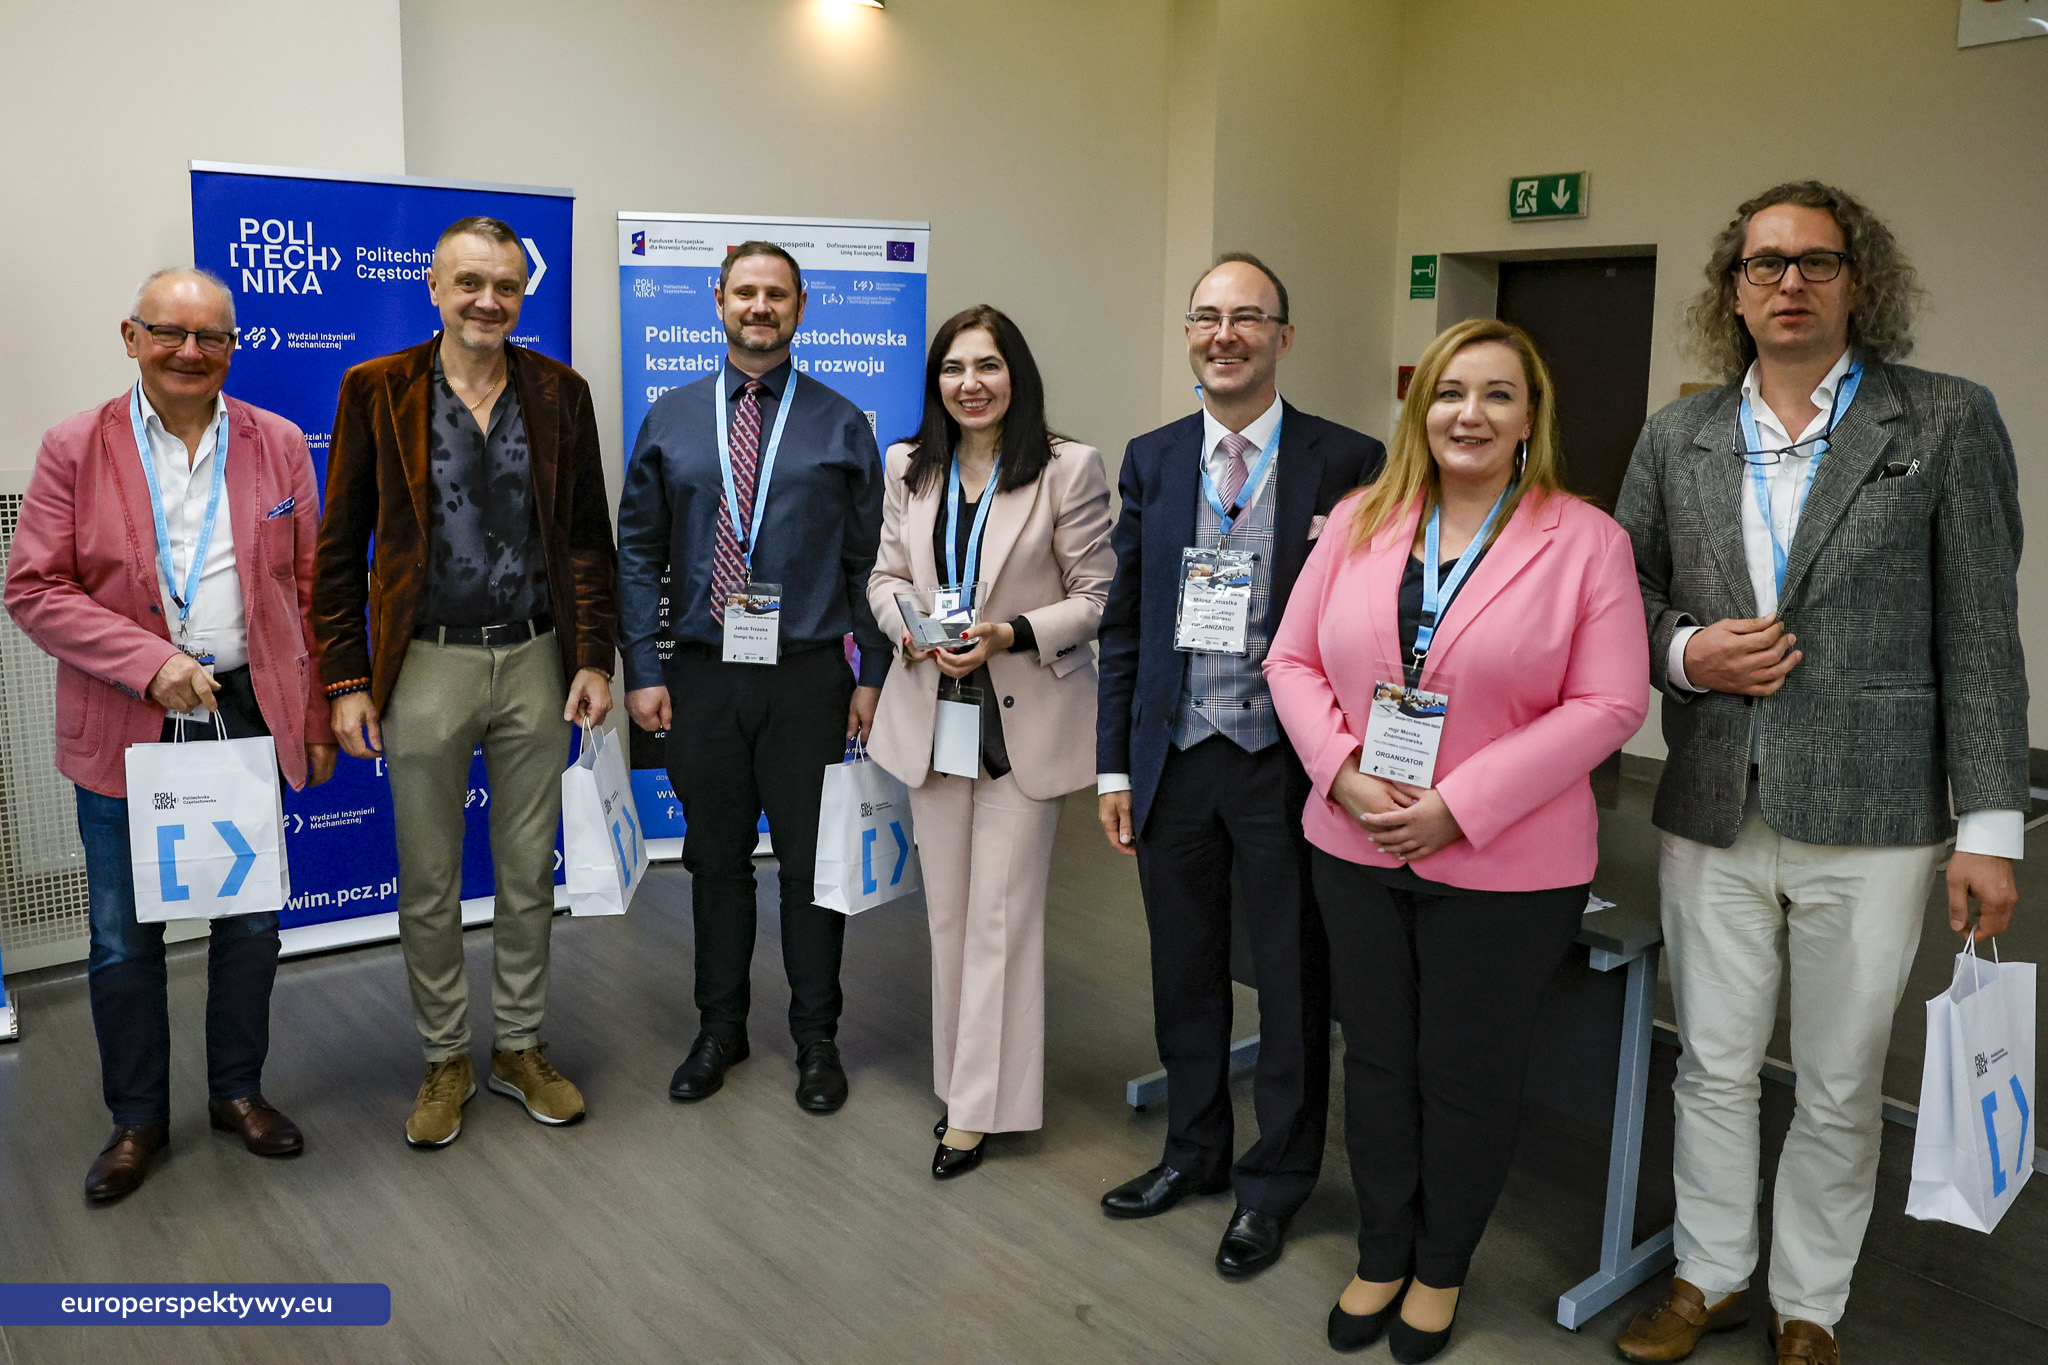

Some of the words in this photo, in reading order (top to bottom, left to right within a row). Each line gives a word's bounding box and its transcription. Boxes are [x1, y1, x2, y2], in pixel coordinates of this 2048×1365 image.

[240, 217, 313, 245] POLI
[763, 240, 815, 248] eczpospolita
[356, 246, 436, 264] Politechni
[356, 264, 428, 282] Częstoch
[242, 268, 323, 295] NIKA
[635, 278, 654, 286] POLI
[635, 290, 656, 298] NIKA
[320, 332, 356, 342] Inżynierii
[645, 325, 728, 343] Politech
[791, 328, 907, 348] ęstochowska
[287, 341, 342, 350] Mechanicznej
[645, 353, 720, 371] kształci
[790, 355, 809, 372] la
[814, 356, 885, 377] rozwoju
[1400, 729, 1421, 738] Monika
[1375, 750, 1424, 766] ORGANIZATOR
[154, 792, 173, 800] POLI
[341, 806, 376, 818] Inżynierii
[310, 817, 362, 830] Mechanicznej
